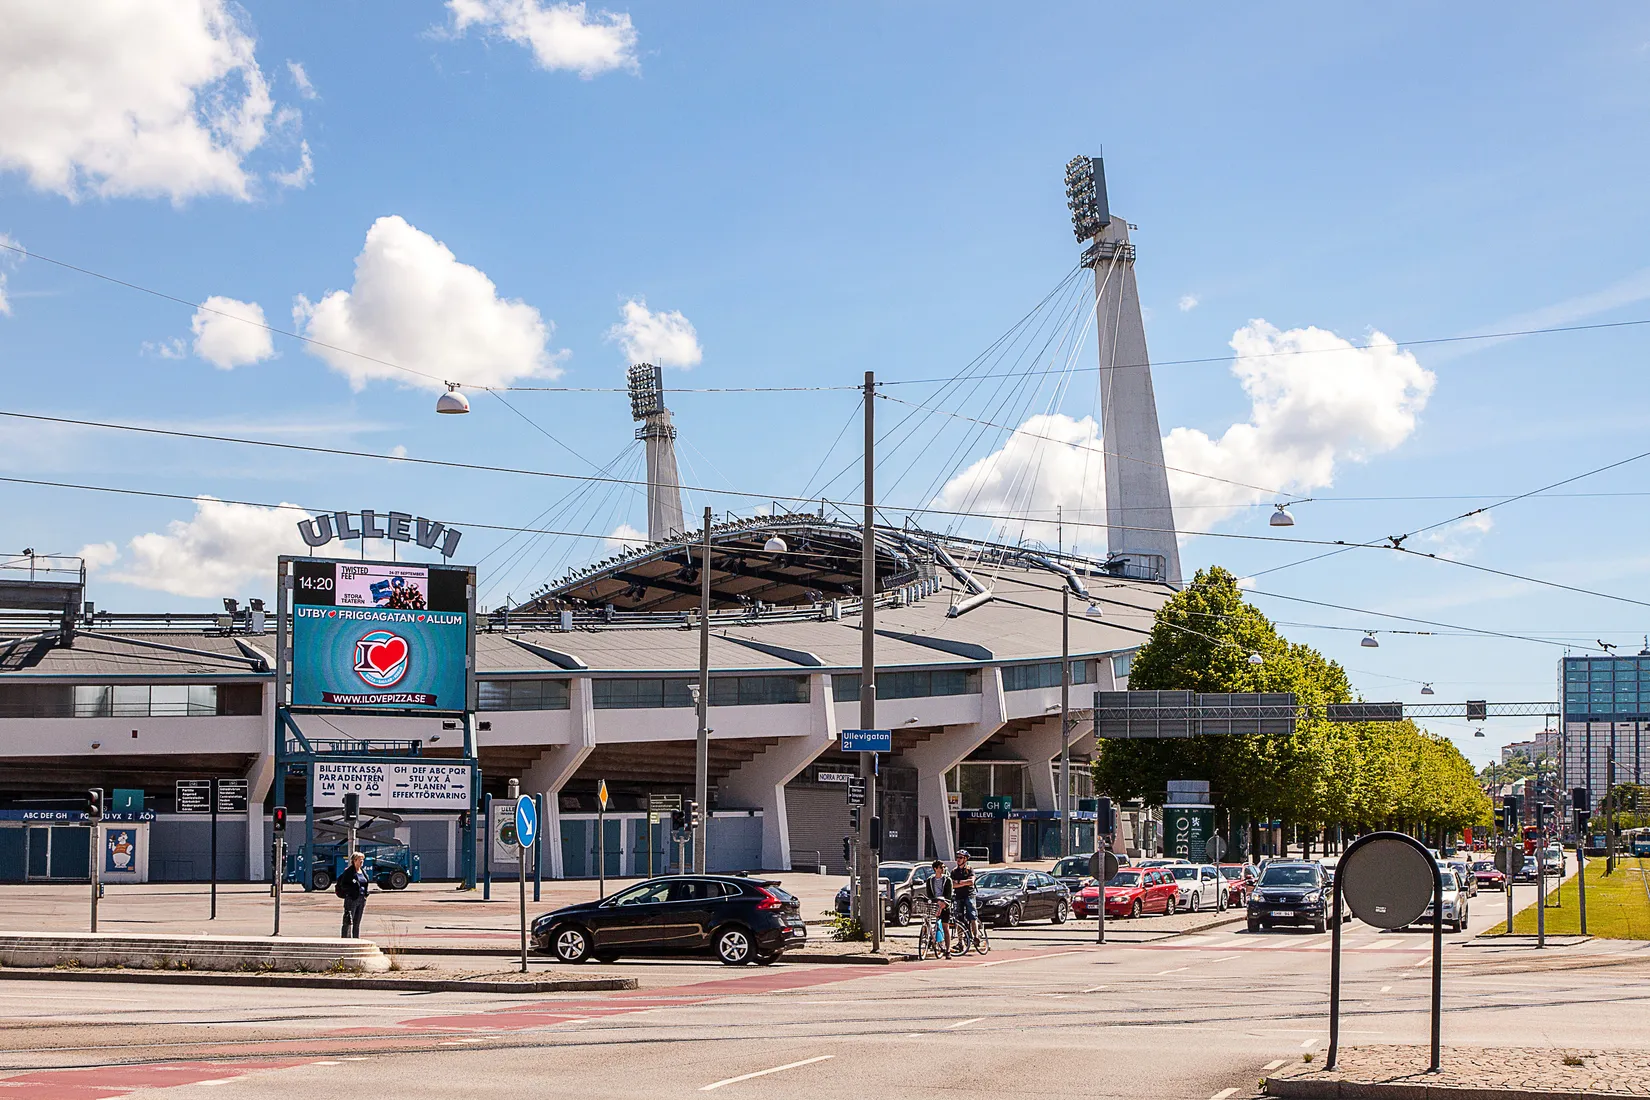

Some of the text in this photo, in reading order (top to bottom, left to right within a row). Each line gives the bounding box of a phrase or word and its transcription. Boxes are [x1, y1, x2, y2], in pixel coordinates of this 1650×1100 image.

[297, 510, 462, 558] ULLEVI
[341, 566, 368, 574] TWISTED
[299, 576, 333, 591] 14:20
[298, 608, 462, 625] UTBY FRIGGAGATAN ALLUM
[333, 694, 426, 704] WWW.ILOVEPIZZA.SE
[844, 732, 889, 742] Ullevigatan
[844, 741, 852, 749] 21
[319, 765, 383, 773] BILJETTKASSA
[394, 766, 407, 774] GH
[319, 773, 384, 782] PARADENTRÉN
[444, 775, 451, 783] Å
[354, 783, 362, 791] O
[365, 782, 380, 791] ÄÖ
[392, 790, 467, 799] EFFEKTFÖRVARING
[125, 796, 132, 807] J
[986, 801, 1000, 810] GH
[1003, 801, 1011, 810] GH
[1176, 817, 1189, 861] BRO
